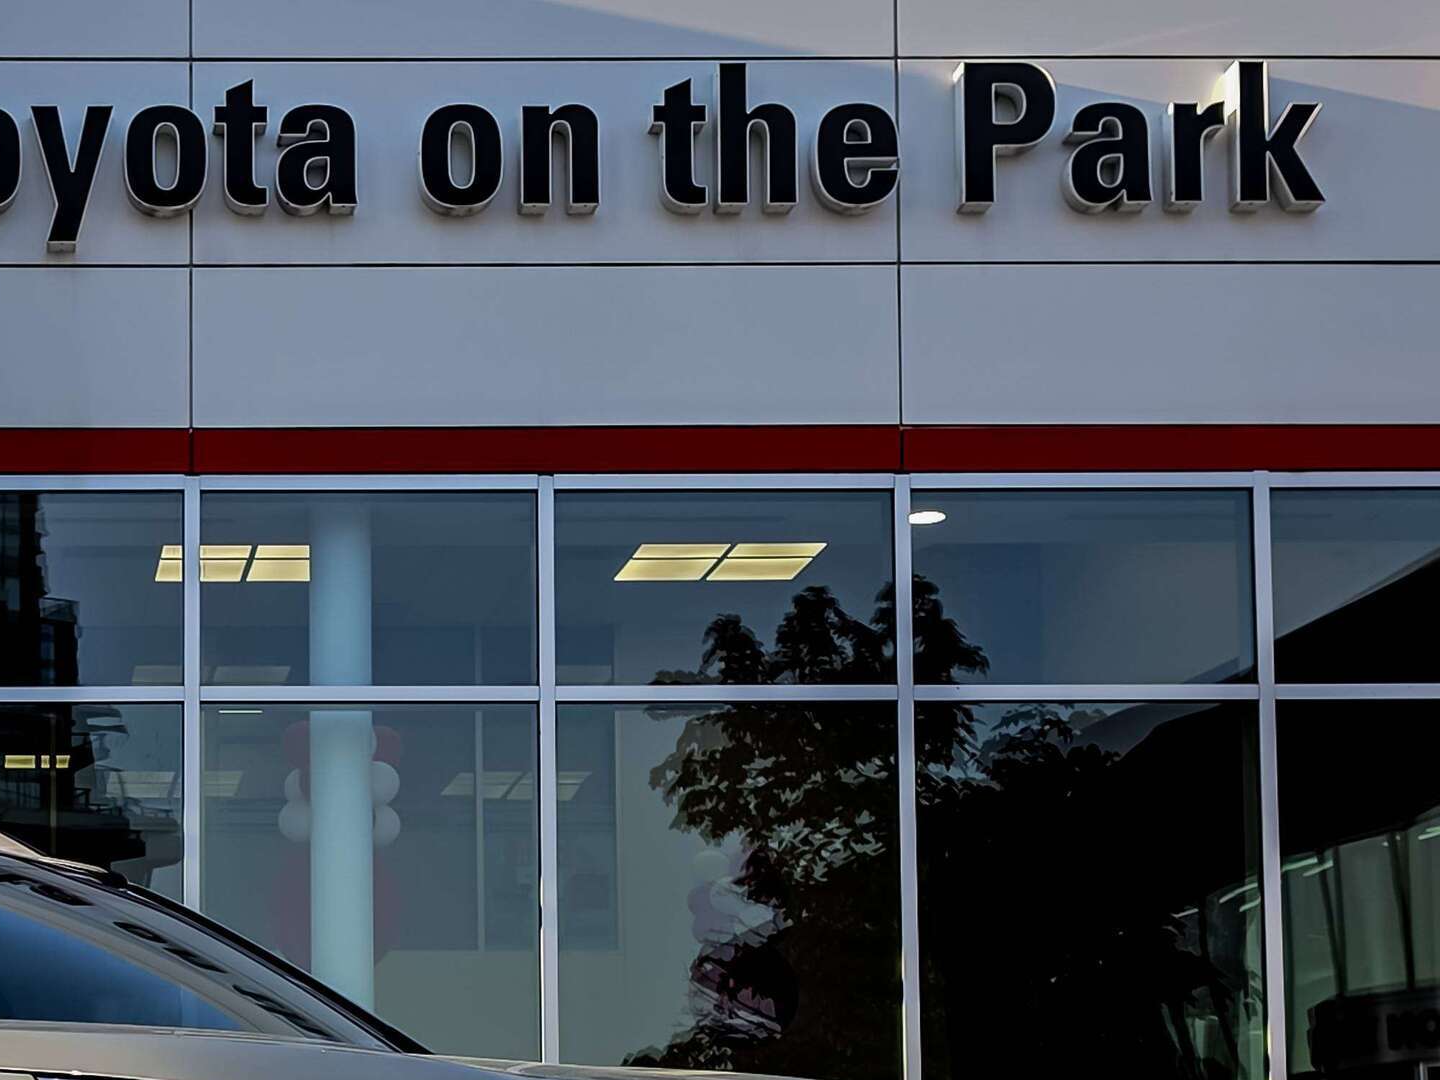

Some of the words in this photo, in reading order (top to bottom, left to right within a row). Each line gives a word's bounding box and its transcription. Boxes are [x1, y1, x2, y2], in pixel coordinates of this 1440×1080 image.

[418, 102, 601, 216] on
[648, 62, 900, 215] the
[953, 60, 1326, 215] Park
